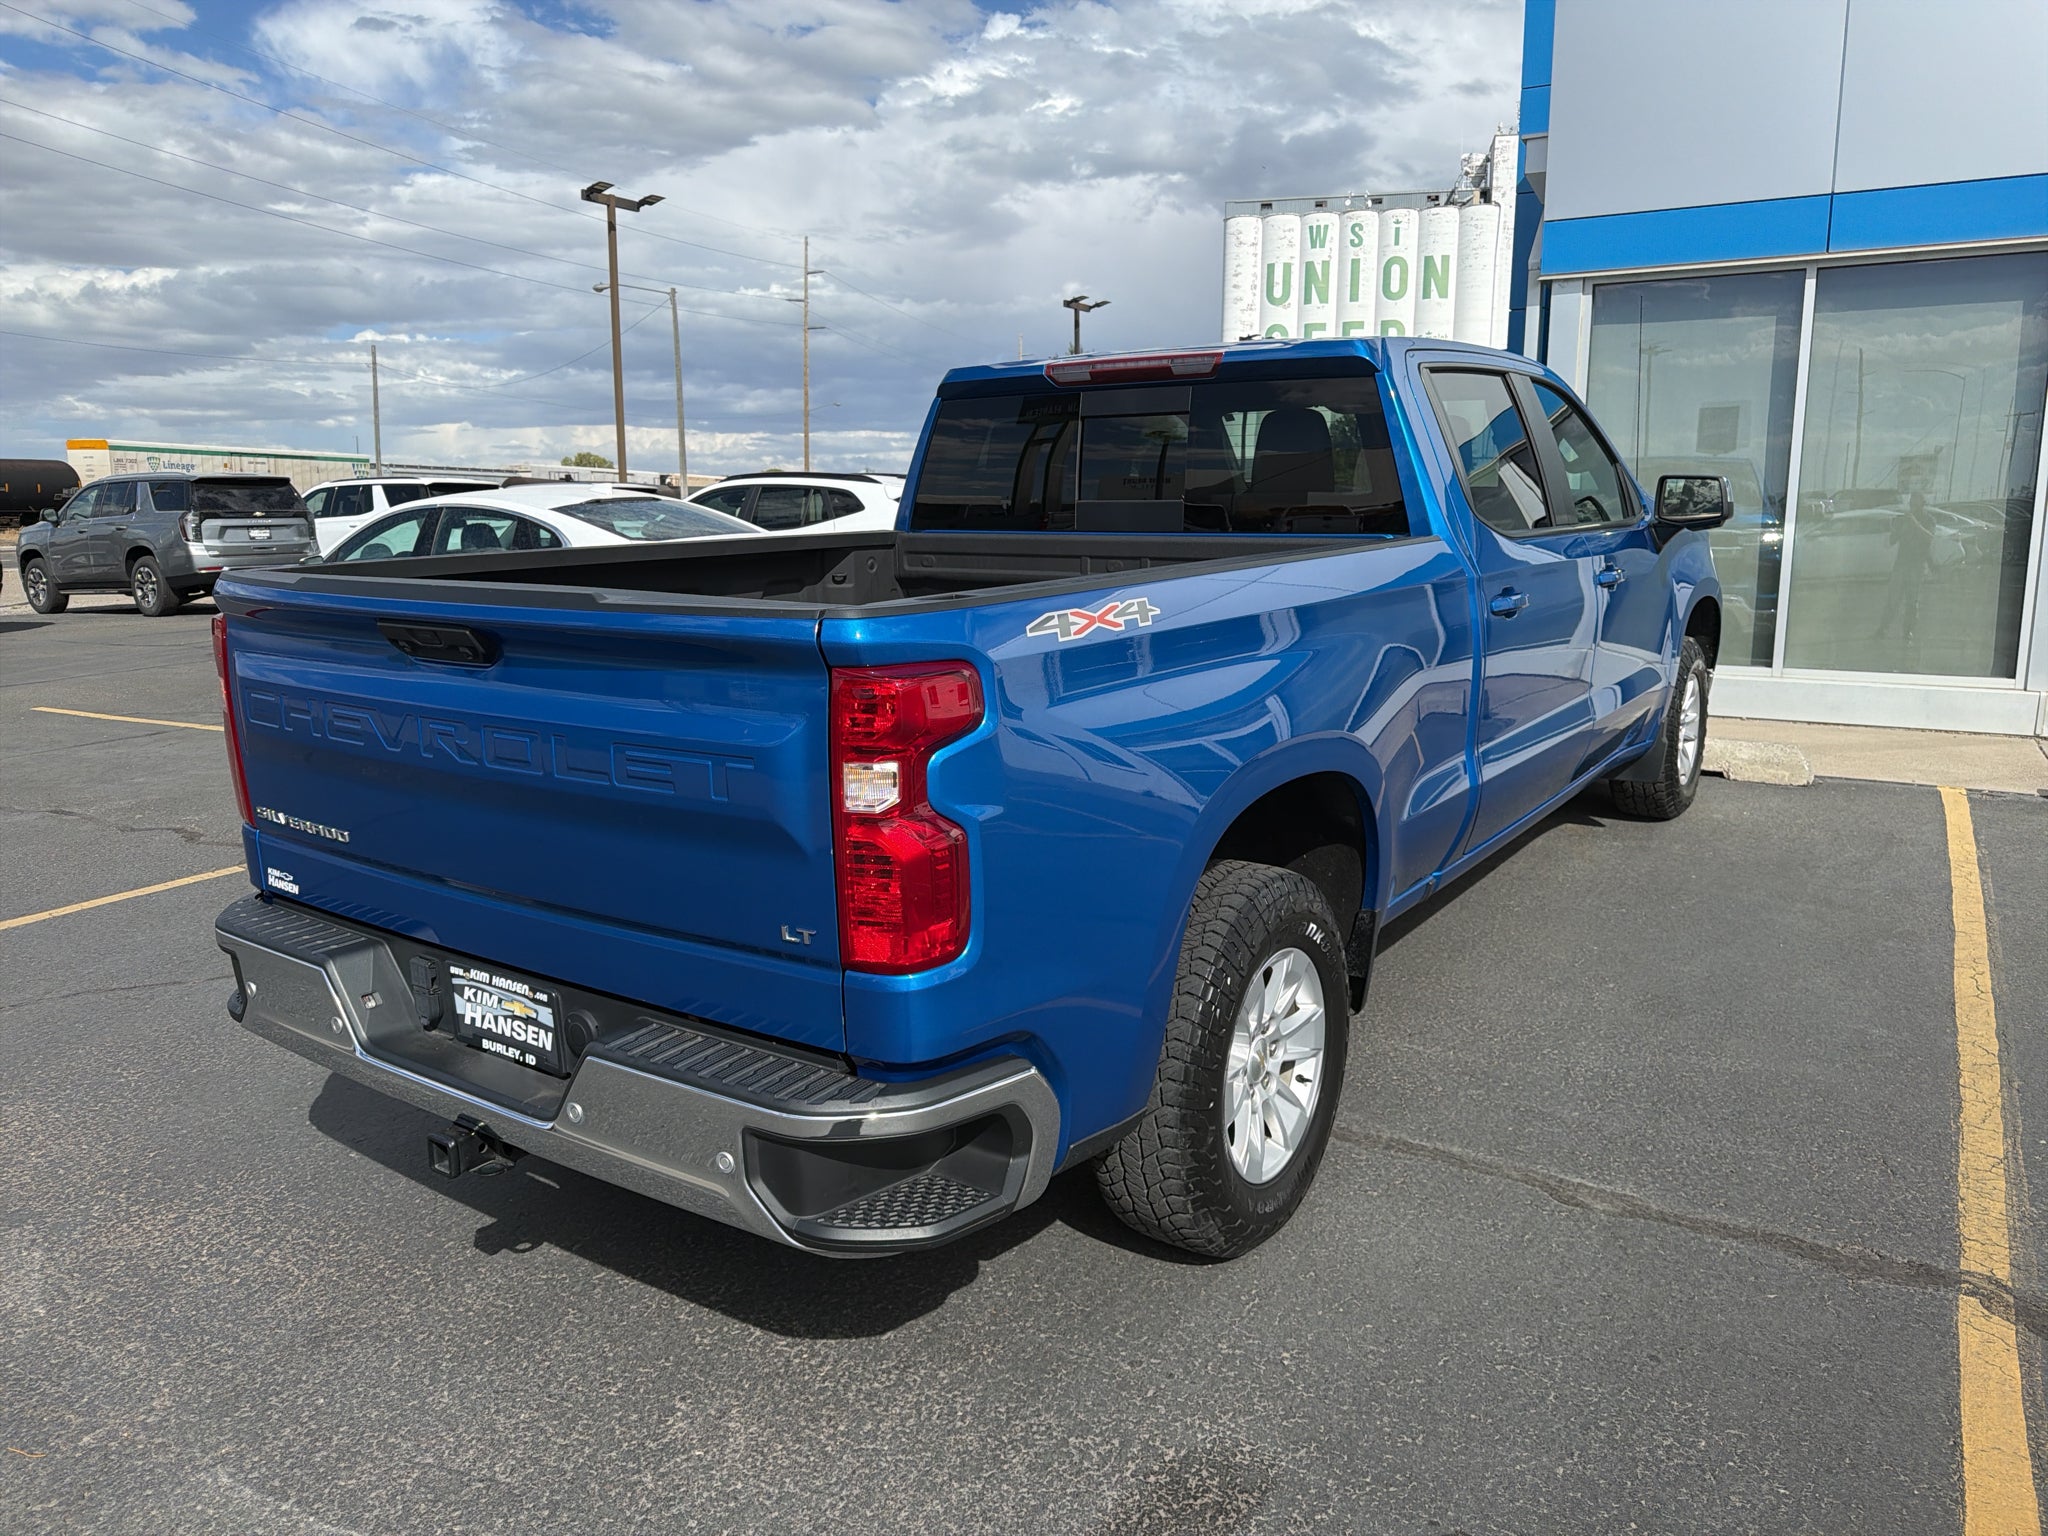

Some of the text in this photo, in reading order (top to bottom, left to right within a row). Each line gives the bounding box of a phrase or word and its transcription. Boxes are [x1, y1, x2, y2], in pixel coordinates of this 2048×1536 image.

[1265, 254, 1450, 306] UNION
[162, 460, 196, 473] Lineage
[246, 687, 755, 801] CHEVROLET
[256, 806, 350, 843] SILVERADO
[267, 867, 281, 879] KIM
[268, 875, 299, 895] HANSEN
[781, 924, 817, 945] LT
[463, 986, 499, 1009] KIM
[464, 1003, 553, 1052] HANSEN
[481, 1038, 536, 1066] BURLEY, ID
